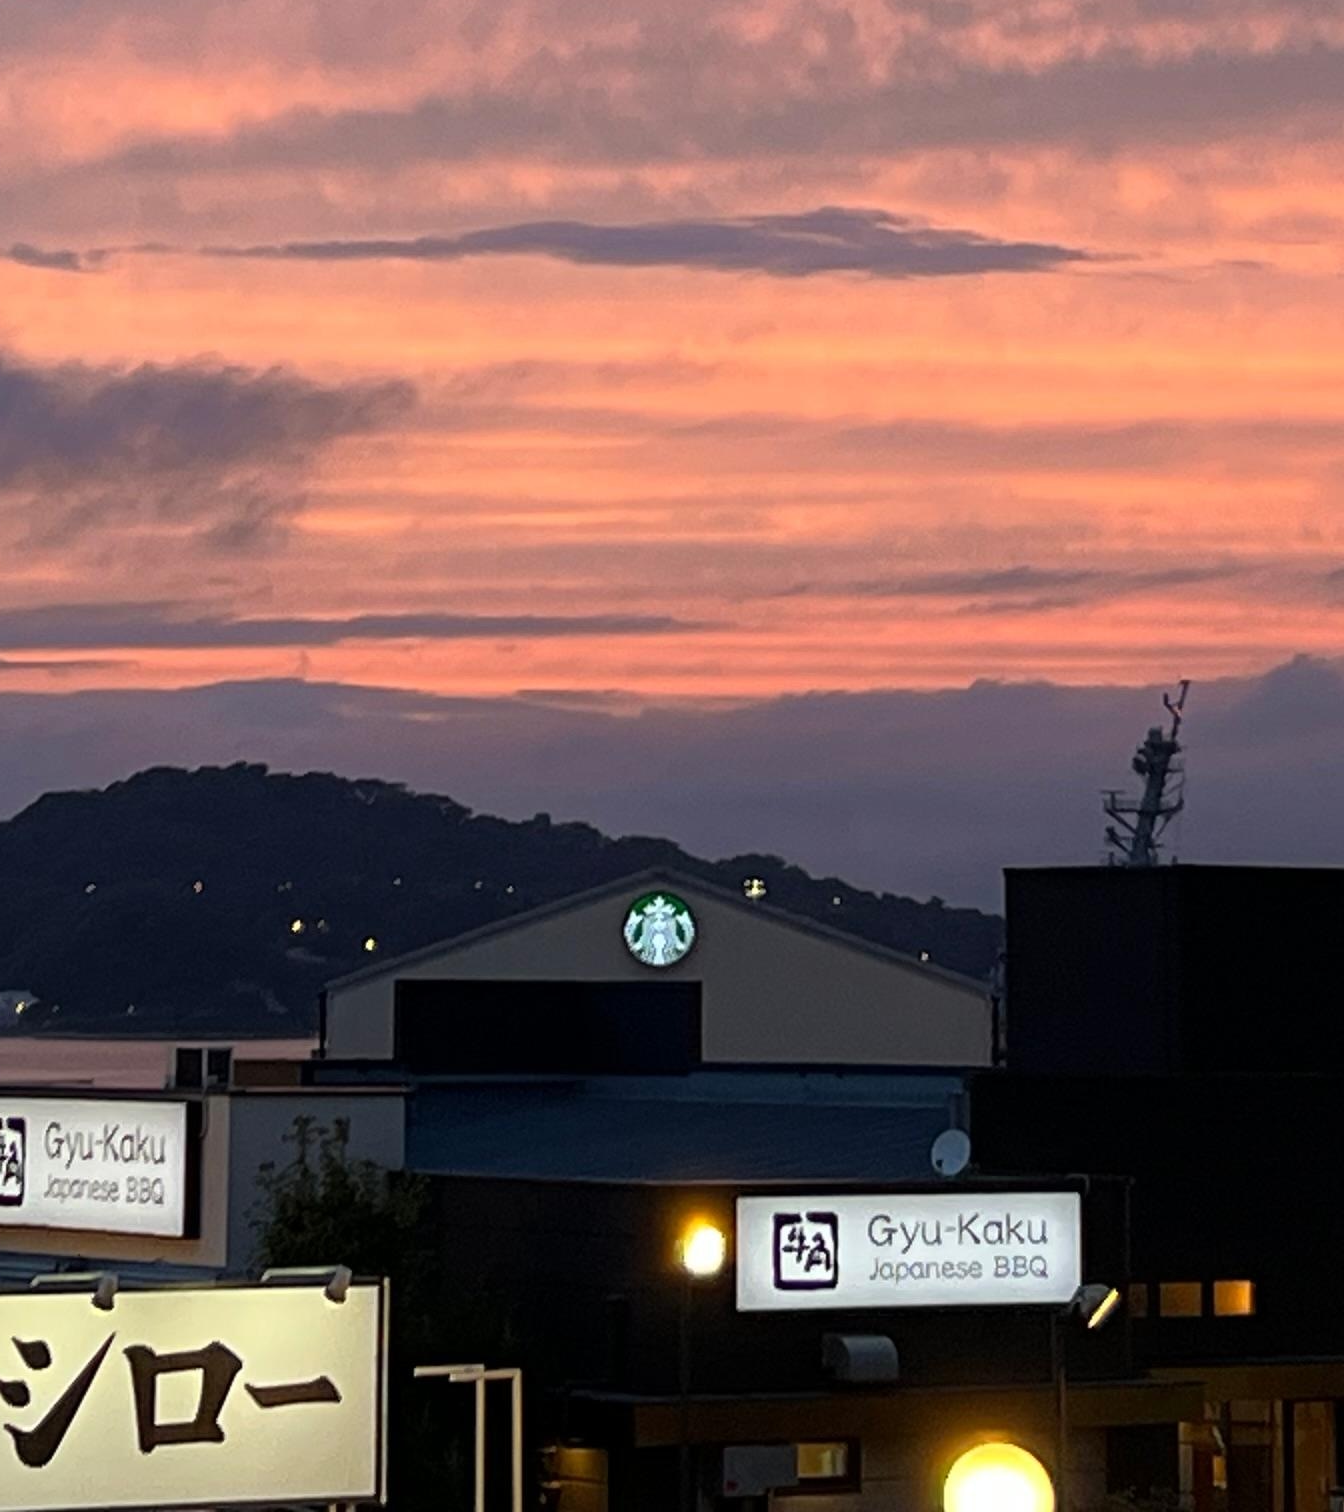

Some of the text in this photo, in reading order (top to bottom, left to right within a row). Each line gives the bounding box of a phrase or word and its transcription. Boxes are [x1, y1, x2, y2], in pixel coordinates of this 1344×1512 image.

[43, 1121, 166, 1170] Gyu-Kaku
[43, 1173, 165, 1205] Japanese BBQ
[867, 1212, 1049, 1255] Gyu-Kaku
[869, 1255, 1049, 1285] Japanese BBQ
